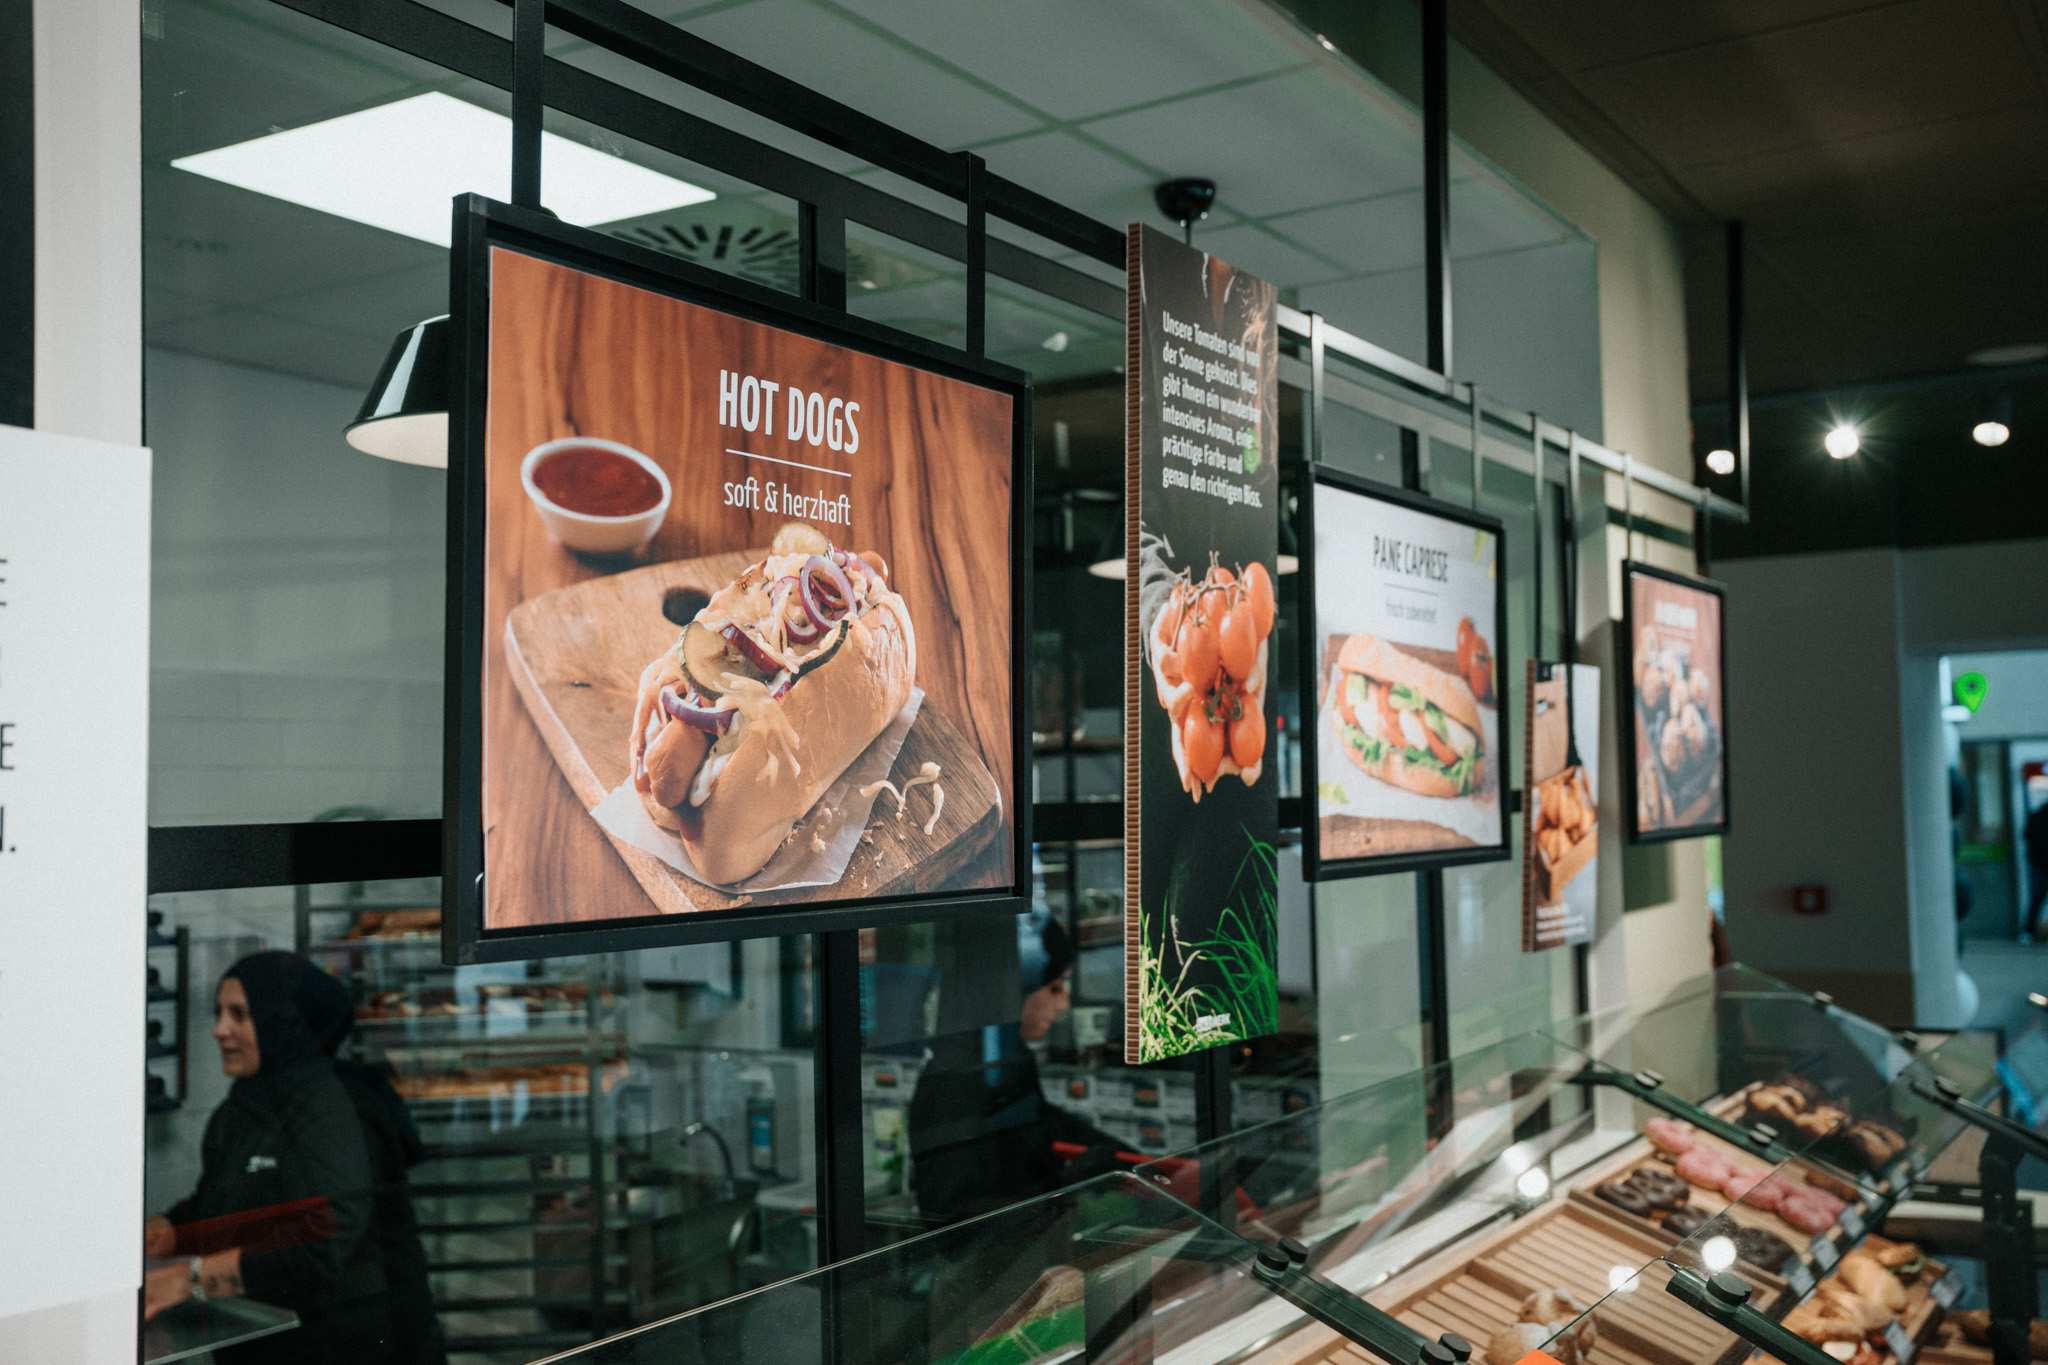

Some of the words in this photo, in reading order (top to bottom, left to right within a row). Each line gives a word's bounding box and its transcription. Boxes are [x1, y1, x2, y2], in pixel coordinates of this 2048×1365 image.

[1163, 310, 1193, 342] Unsere
[1193, 322, 1227, 356] Tomaten
[1228, 339, 1245, 362] sind
[1245, 349, 1260, 369] von
[1163, 341, 1178, 365] der
[1179, 347, 1204, 376] Sonne
[1205, 360, 1241, 389] geküsst.
[1241, 370, 1258, 396] Dies
[719, 369, 780, 436] HOT
[788, 386, 861, 454] DOGS
[1163, 373, 1181, 398] gibt
[1182, 377, 1205, 405] ihnen
[1206, 388, 1220, 410] ein
[1220, 396, 1262, 424] wunderbar
[1163, 401, 1206, 435] intensives
[1206, 416, 1235, 446] Aroma,
[1236, 426, 1253, 449] eine
[1163, 434, 1203, 467] prächtige
[1204, 444, 1226, 470] Farbe
[1227, 454, 1243, 475] und
[724, 476, 760, 510] soft
[764, 481, 778, 513] &
[783, 483, 851, 526] herzhaft
[1162, 467, 1189, 488] genau
[1190, 469, 1206, 493] den
[1207, 474, 1243, 505] richtigen
[1243, 484, 1262, 508] Biss.
[1373, 535, 1402, 573] PANE
[1404, 542, 1448, 583] CAPRESE
